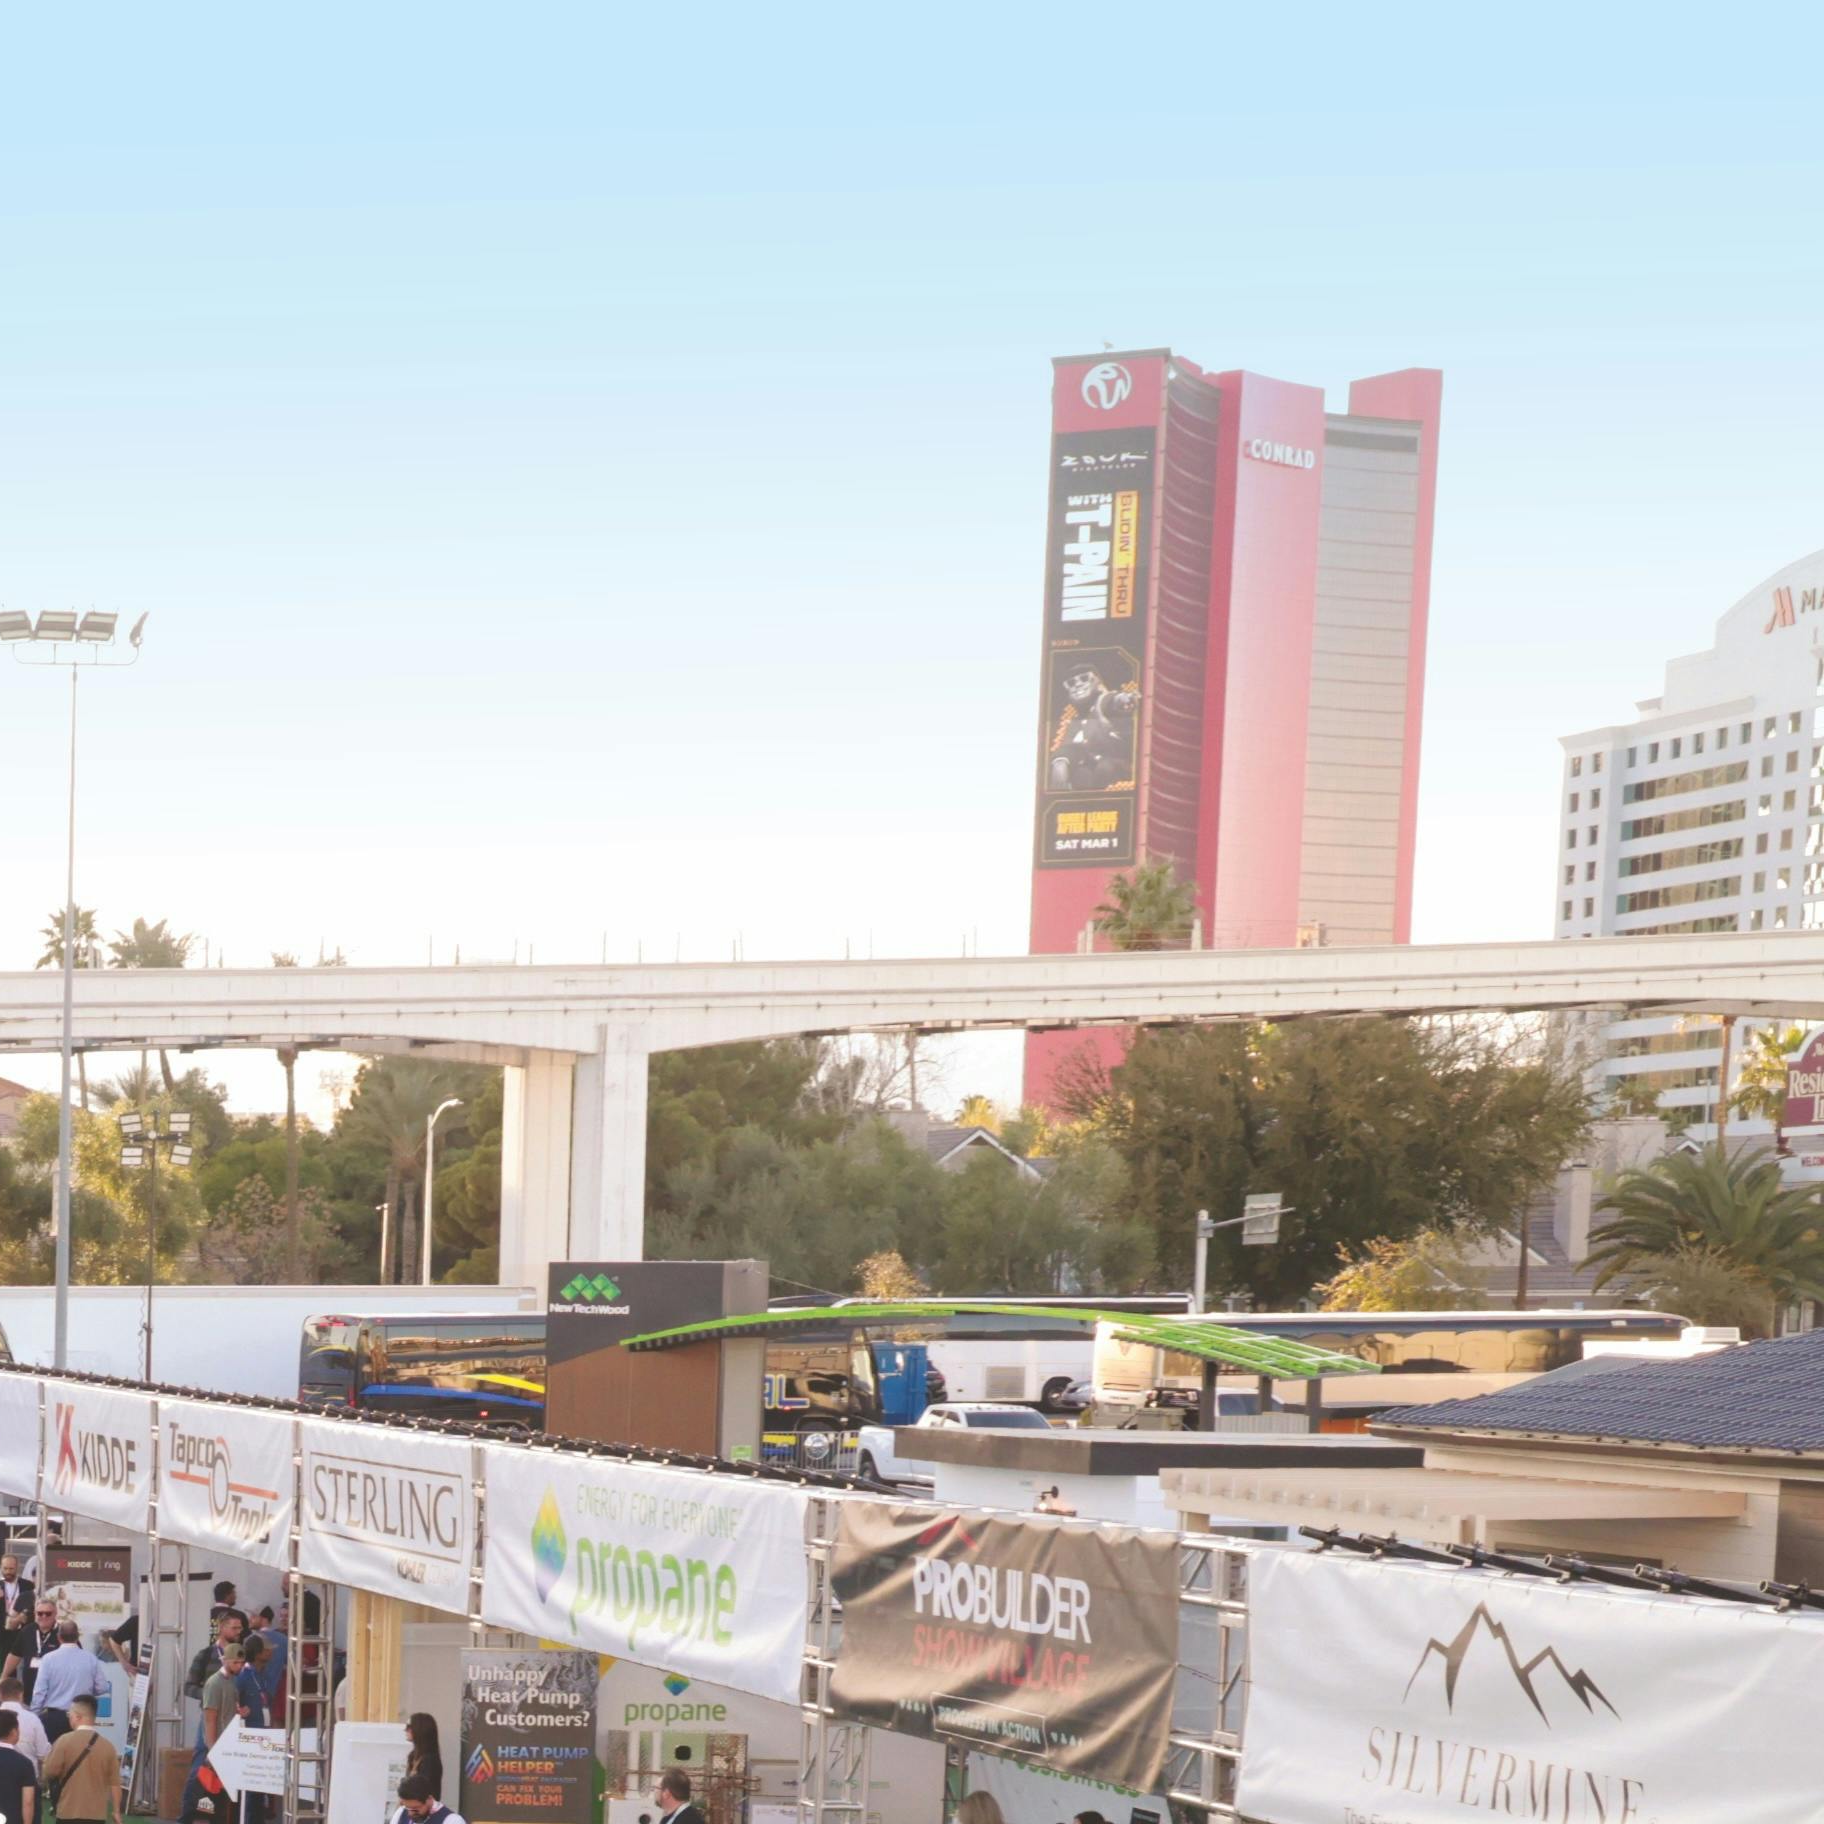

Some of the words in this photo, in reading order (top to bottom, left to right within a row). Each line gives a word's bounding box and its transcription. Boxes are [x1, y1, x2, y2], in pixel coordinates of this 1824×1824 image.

[1249, 437, 1316, 470] CONRAD
[1067, 493, 1113, 506] WITH
[1061, 503, 1113, 622] T-PAIN
[1115, 564, 1130, 615] THRU
[1055, 839, 1078, 850] SAT
[1081, 838, 1109, 849] MAR
[1111, 838, 1119, 848] 1
[78, 1429, 136, 1495] KIDDE
[169, 1422, 215, 1473] Tapco
[230, 1495, 273, 1545] Tools
[313, 1465, 457, 1548] STERLING
[576, 1484, 625, 1521] ENERGY
[630, 1493, 657, 1526] FOR
[662, 1499, 738, 1541] EVERYONE
[570, 1537, 737, 1651] propane
[912, 1556, 1091, 1643] PROBUILDER
[468, 1664, 548, 1686] Unhappy
[912, 1624, 983, 1667] SHOW
[984, 1636, 1091, 1697] VILLAGE
[477, 1686, 519, 1704] Heat
[527, 1688, 581, 1709] Pump
[485, 1708, 591, 1727] Customers?
[624, 1702, 727, 1726] propane
[938, 1705, 987, 1732] PROGRESS
[988, 1718, 999, 1734] IN
[1002, 1721, 1041, 1744] ACTION
[497, 1746, 539, 1758] HEAT
[543, 1747, 589, 1759] PUMP
[496, 1793, 563, 1806] PROBLEM!
